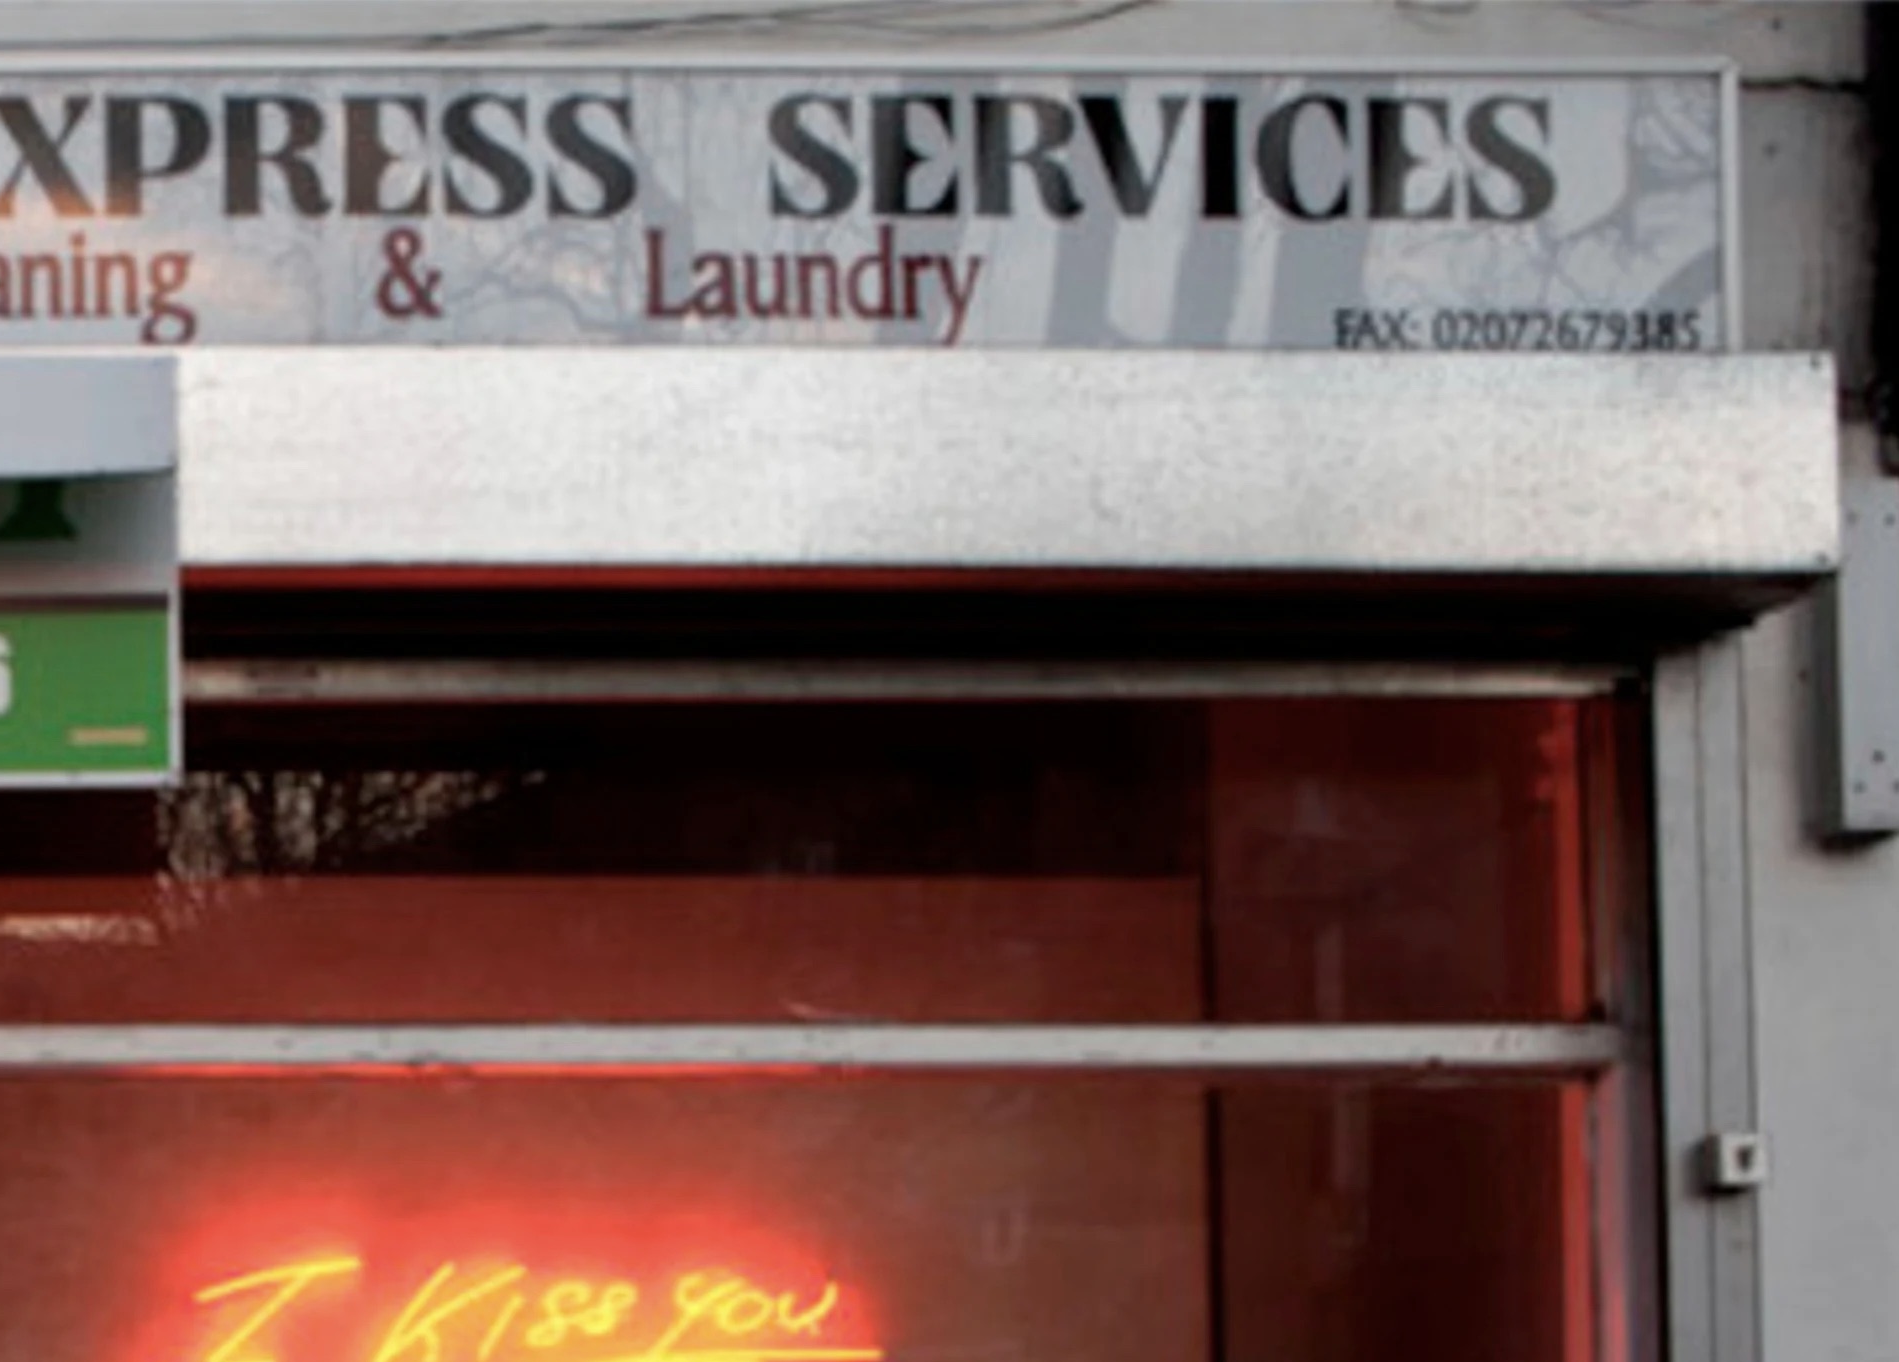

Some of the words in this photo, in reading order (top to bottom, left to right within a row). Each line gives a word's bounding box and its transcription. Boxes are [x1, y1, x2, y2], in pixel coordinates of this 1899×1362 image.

[767, 91, 1557, 222] SERVICES
[375, 226, 443, 319] &
[645, 222, 982, 347] Laundry
[1335, 308, 1421, 351] FAX:
